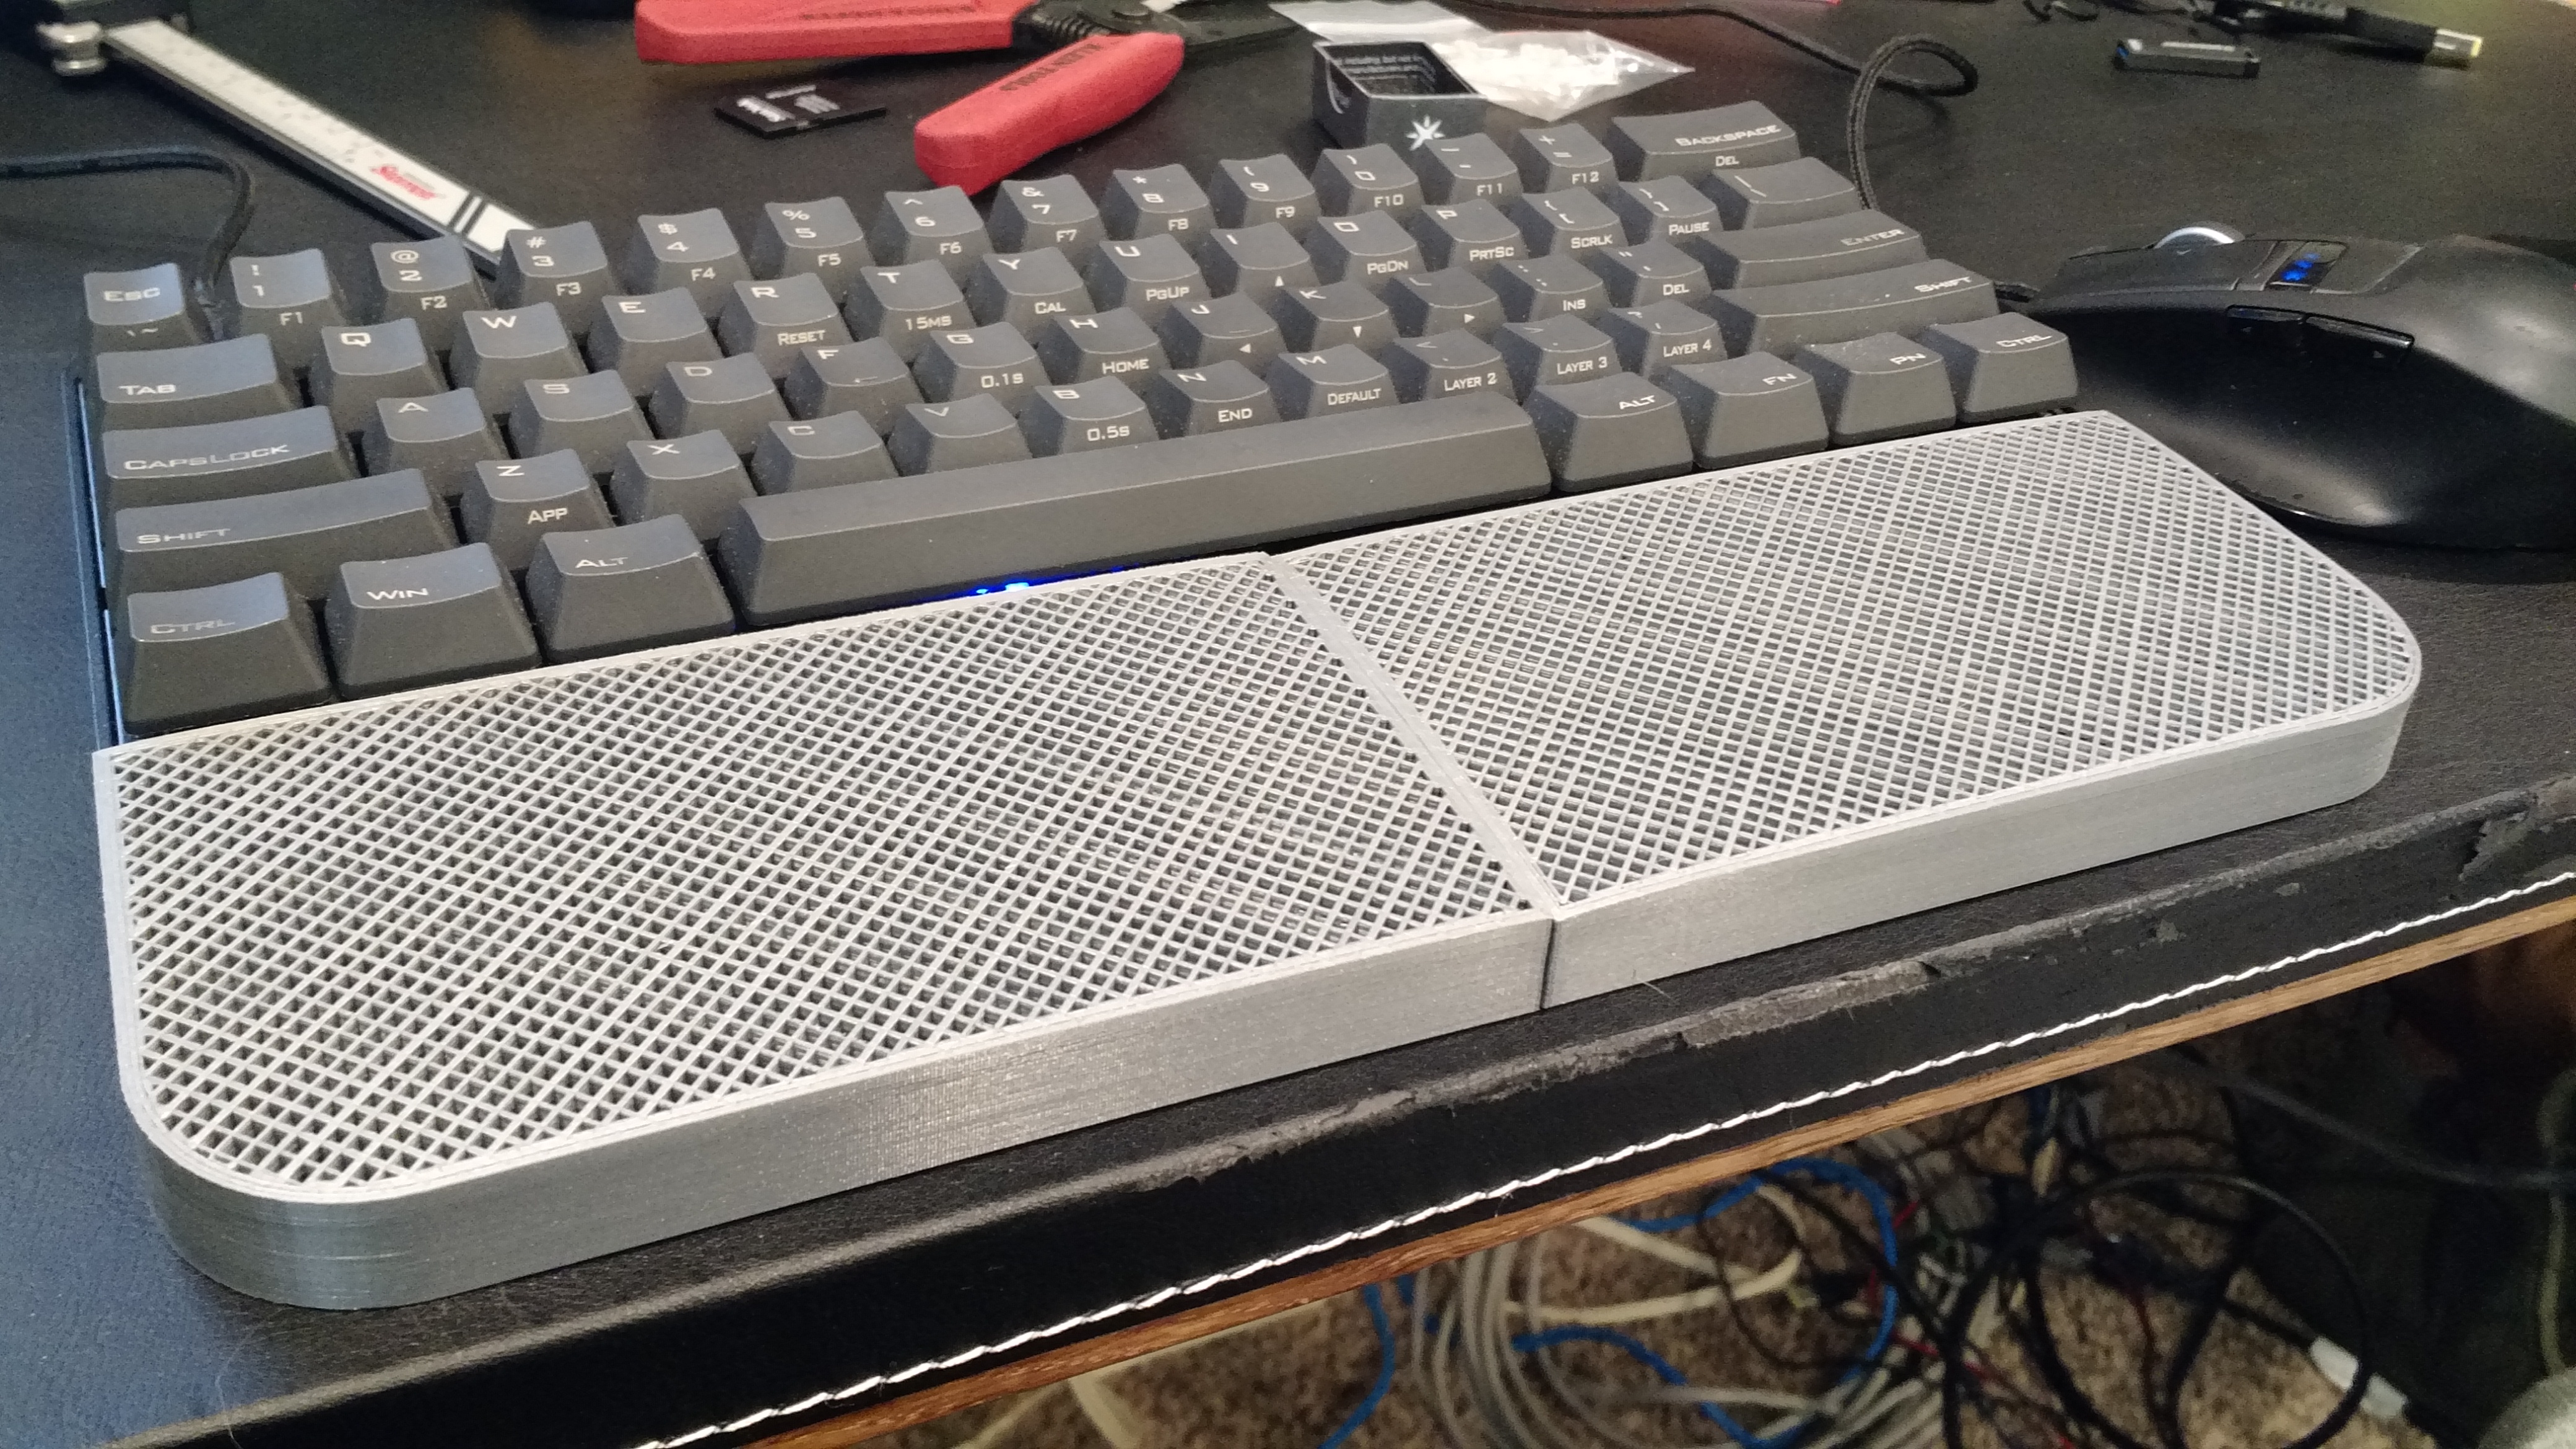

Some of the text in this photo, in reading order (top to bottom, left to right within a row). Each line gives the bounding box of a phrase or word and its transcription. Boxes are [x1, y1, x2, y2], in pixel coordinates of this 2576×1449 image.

[1675, 125, 1781, 146] BACKSPACE
[1716, 156, 1739, 166] DEL
[1572, 172, 1599, 184] F12
[1250, 183, 1269, 191] 9
[1477, 183, 1502, 196] F11
[1142, 194, 1164, 202] 8
[1375, 194, 1403, 207] F10
[1032, 204, 1050, 214] 7
[1276, 206, 1295, 218] F9
[1436, 210, 1457, 219] P
[915, 217, 935, 226] 6
[1168, 219, 1188, 230] F8
[1334, 222, 1359, 232] O
[796, 228, 816, 238] 5
[1669, 222, 1709, 235] PAUSE
[1056, 229, 1077, 242] F7
[1841, 230, 1905, 246] ENTER
[667, 242, 688, 251] 4
[1572, 235, 1612, 248] SCRLK
[941, 242, 961, 255] F6
[1115, 246, 1140, 256] U
[1469, 246, 1513, 261] PRTSC
[532, 256, 554, 266] 3
[818, 253, 841, 266] F5
[999, 259, 1020, 269] Y
[1367, 261, 1408, 274] PGDN
[400, 271, 422, 281] 2
[692, 268, 715, 281] F4
[878, 272, 900, 283] T
[254, 285, 264, 296] 1
[557, 282, 581, 295] F3
[1663, 284, 1689, 295] DEL
[1915, 276, 1972, 294] SHIFT
[751, 287, 778, 297] R
[1146, 287, 1189, 301] PGUP
[1300, 290, 1325, 298] K
[422, 296, 447, 310] F2
[619, 302, 645, 313] E
[1035, 302, 1066, 314] CAL
[1564, 299, 1585, 310] INS
[1191, 305, 1209, 314] J
[281, 312, 302, 325] F1
[482, 316, 516, 328] W
[1069, 319, 1098, 328] H
[341, 333, 371, 346] Q
[778, 330, 825, 346] RESET
[947, 334, 973, 344] G
[1997, 334, 2052, 348] CTRL
[1664, 339, 1711, 357] LAYER 4
[817, 350, 838, 359] F
[1890, 354, 1926, 364] PN
[1103, 359, 1149, 373] HOME
[1295, 356, 1326, 365] M
[1557, 357, 1607, 375] LAYER 3
[684, 367, 712, 376] D
[1178, 373, 1206, 381] N
[981, 373, 1023, 388] 0.1S
[1445, 373, 1497, 391] LAYER 2
[1763, 373, 1796, 385] FN
[120, 385, 175, 395] TAB
[543, 384, 569, 394] S
[1053, 390, 1079, 399] B
[1328, 388, 1381, 405] DEFAULT
[1619, 394, 1656, 410] ALT
[399, 402, 428, 412] A
[925, 407, 949, 416] V
[1219, 408, 1252, 422] END
[788, 426, 814, 435] C
[1087, 426, 1129, 441] 0.5S
[649, 445, 679, 455] X
[124, 445, 289, 469] CAPSLOCK
[497, 466, 524, 476] Z
[528, 508, 567, 524] APP
[137, 528, 230, 544] SHIFT
[575, 558, 626, 568] ALT
[367, 588, 428, 599] WIN
[150, 619, 235, 634] CTRL
